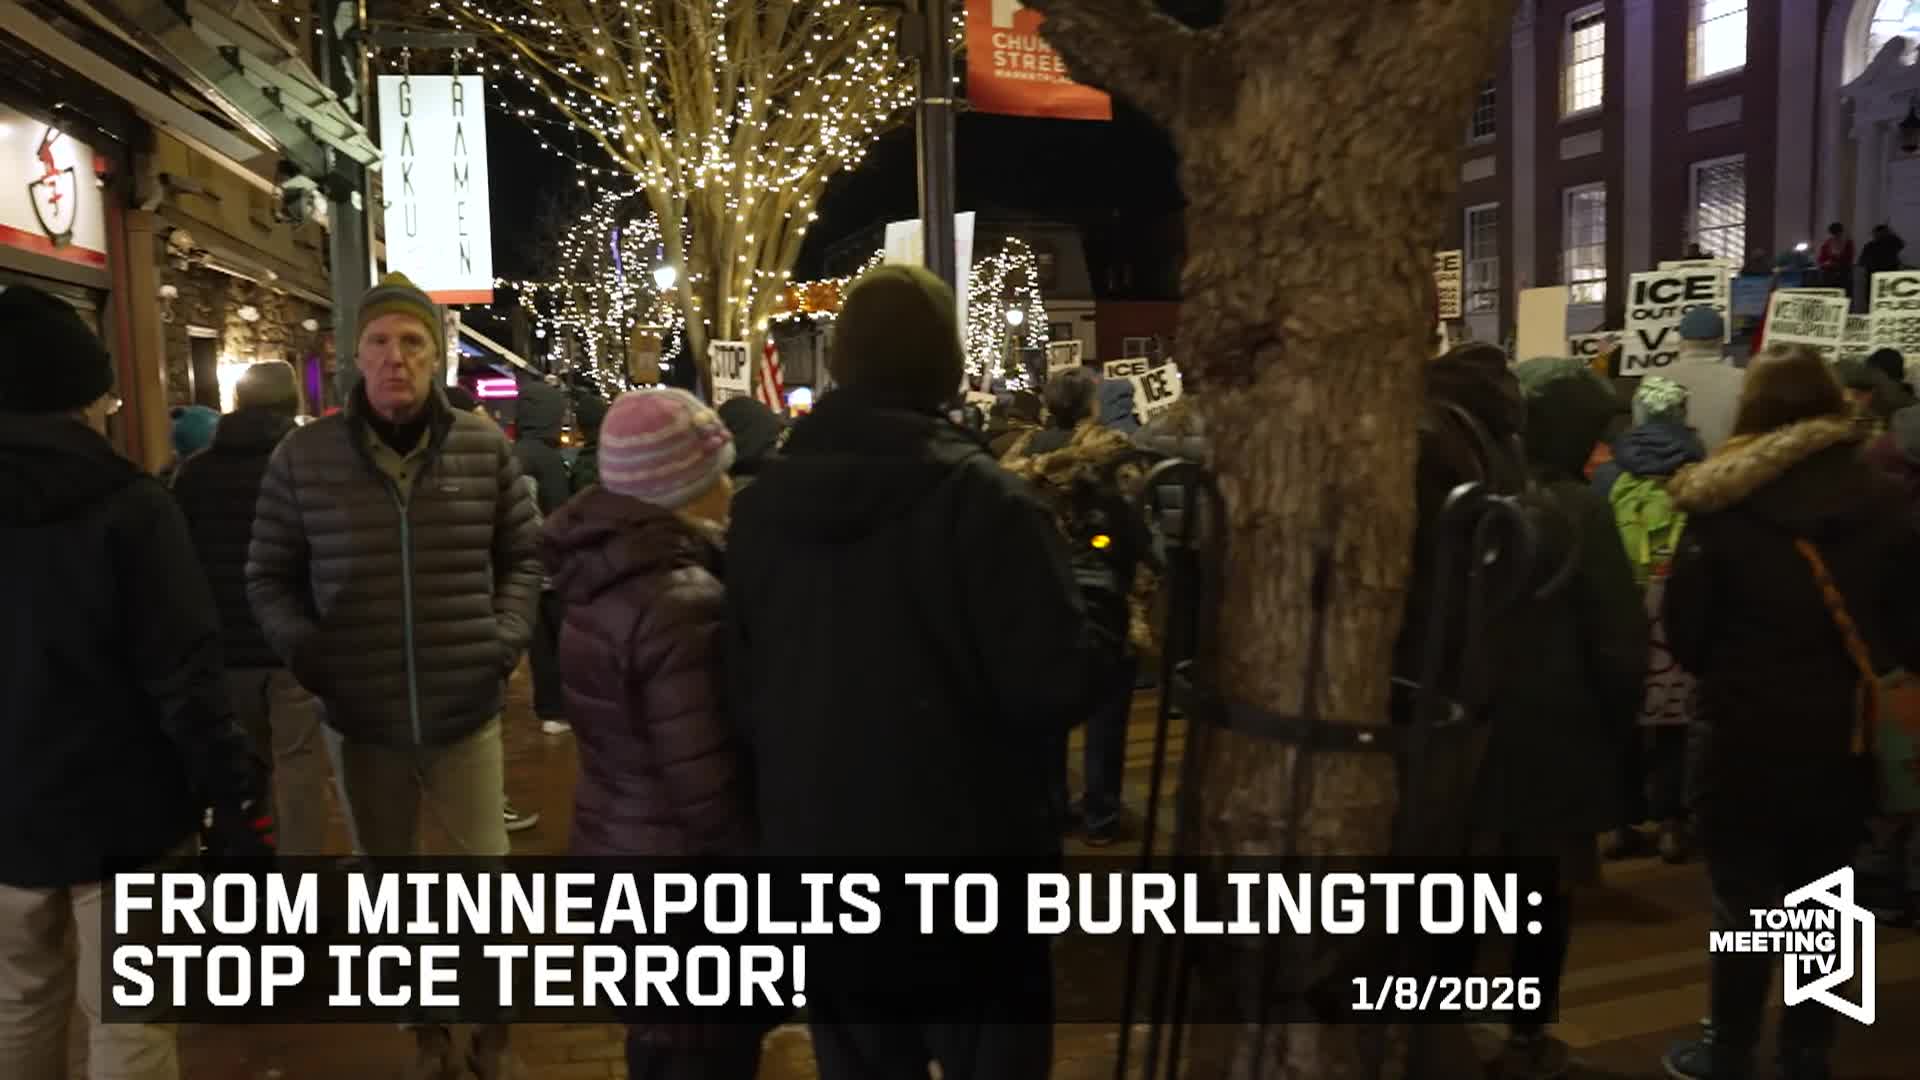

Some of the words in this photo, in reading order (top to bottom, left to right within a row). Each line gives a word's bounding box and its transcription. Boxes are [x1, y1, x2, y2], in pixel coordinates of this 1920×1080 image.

[992, 32, 1053, 53] CHUR
[992, 50, 1067, 72] STREE
[398, 80, 417, 238] GAKU
[451, 80, 472, 276] RAMEN
[1634, 275, 1716, 306] ICE
[1877, 276, 1920, 298] IC
[1631, 306, 1678, 321] OUT
[1571, 338, 1602, 356] IC
[712, 345, 746, 380] STOP
[1107, 361, 1147, 378] ICE
[1626, 351, 1679, 370] NO
[1140, 369, 1173, 402] ICE
